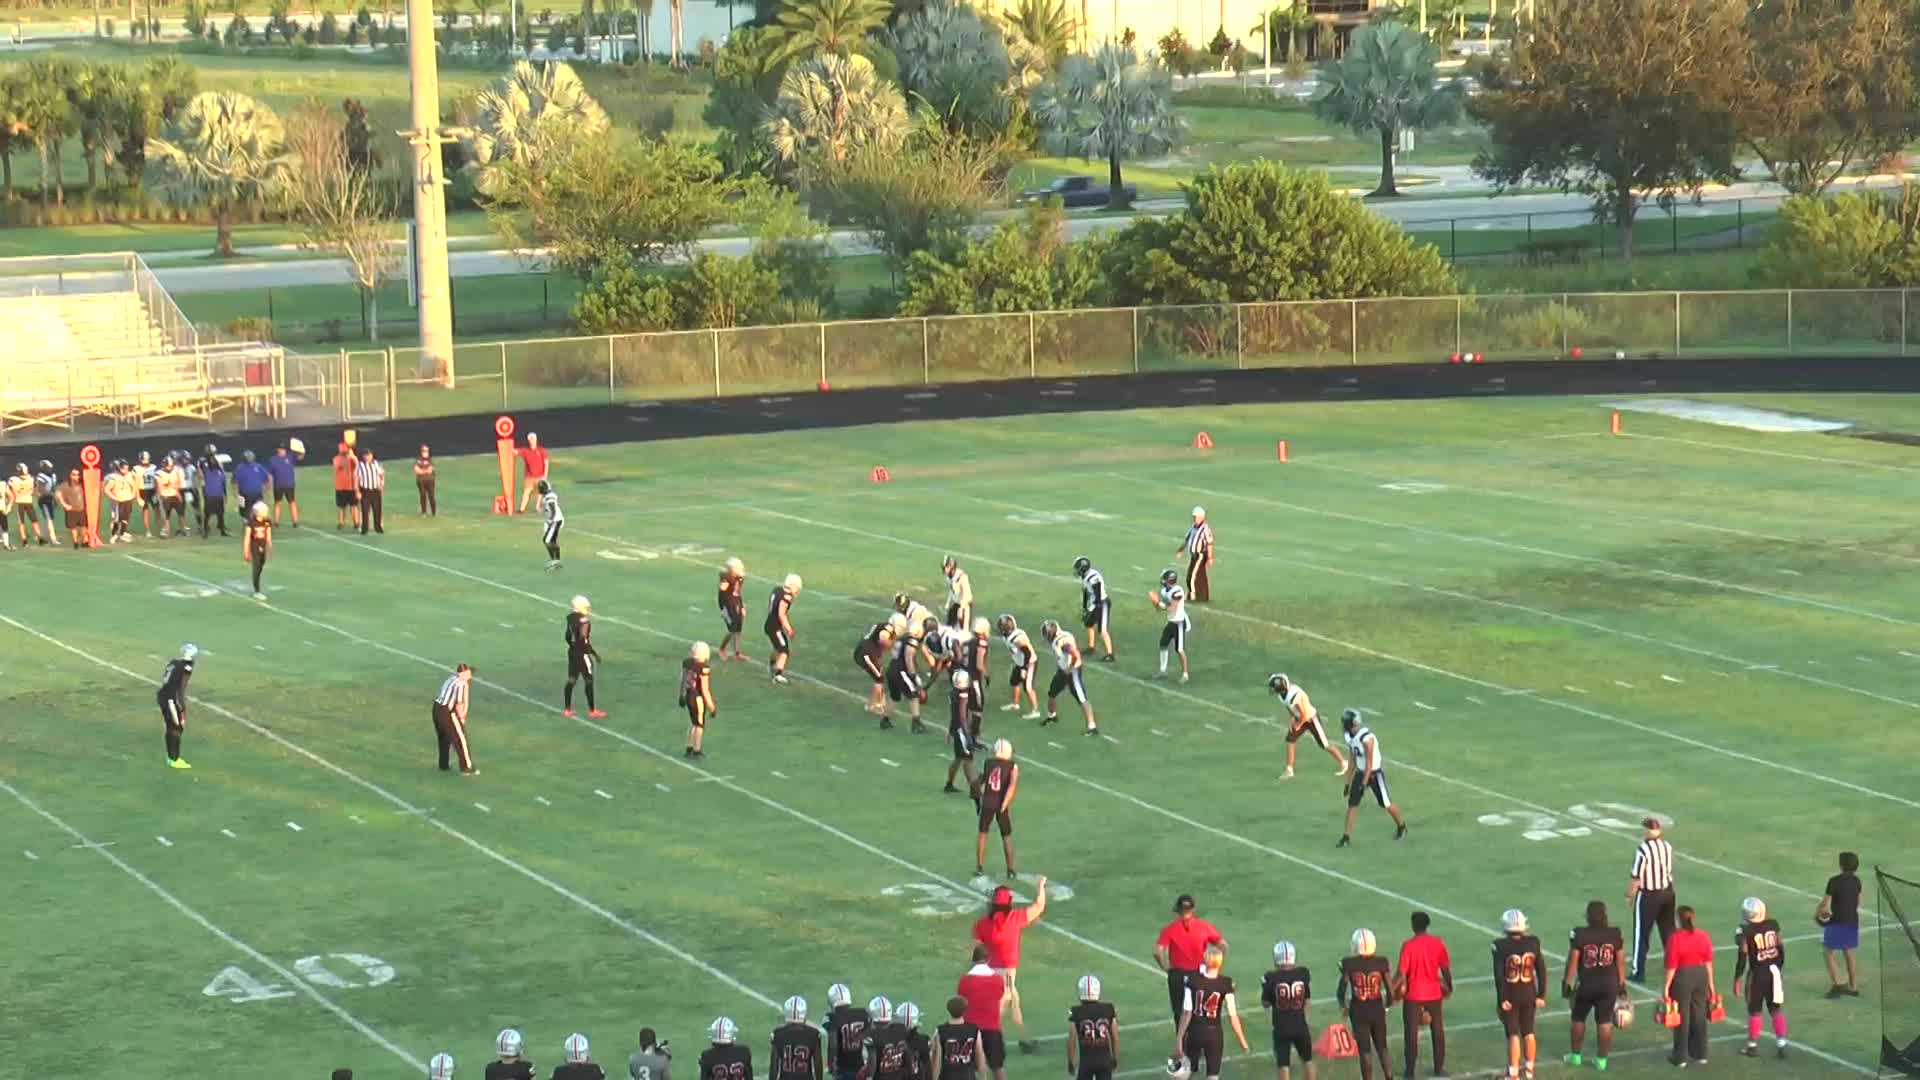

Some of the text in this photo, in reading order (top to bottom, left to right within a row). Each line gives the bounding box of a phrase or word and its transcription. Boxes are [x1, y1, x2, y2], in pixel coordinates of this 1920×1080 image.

[989, 767, 1001, 791] 4
[202, 953, 395, 1003] 40
[1193, 990, 1221, 1018] 14
[639, 1065, 650, 1080] 3
[783, 1044, 810, 1073] 12
